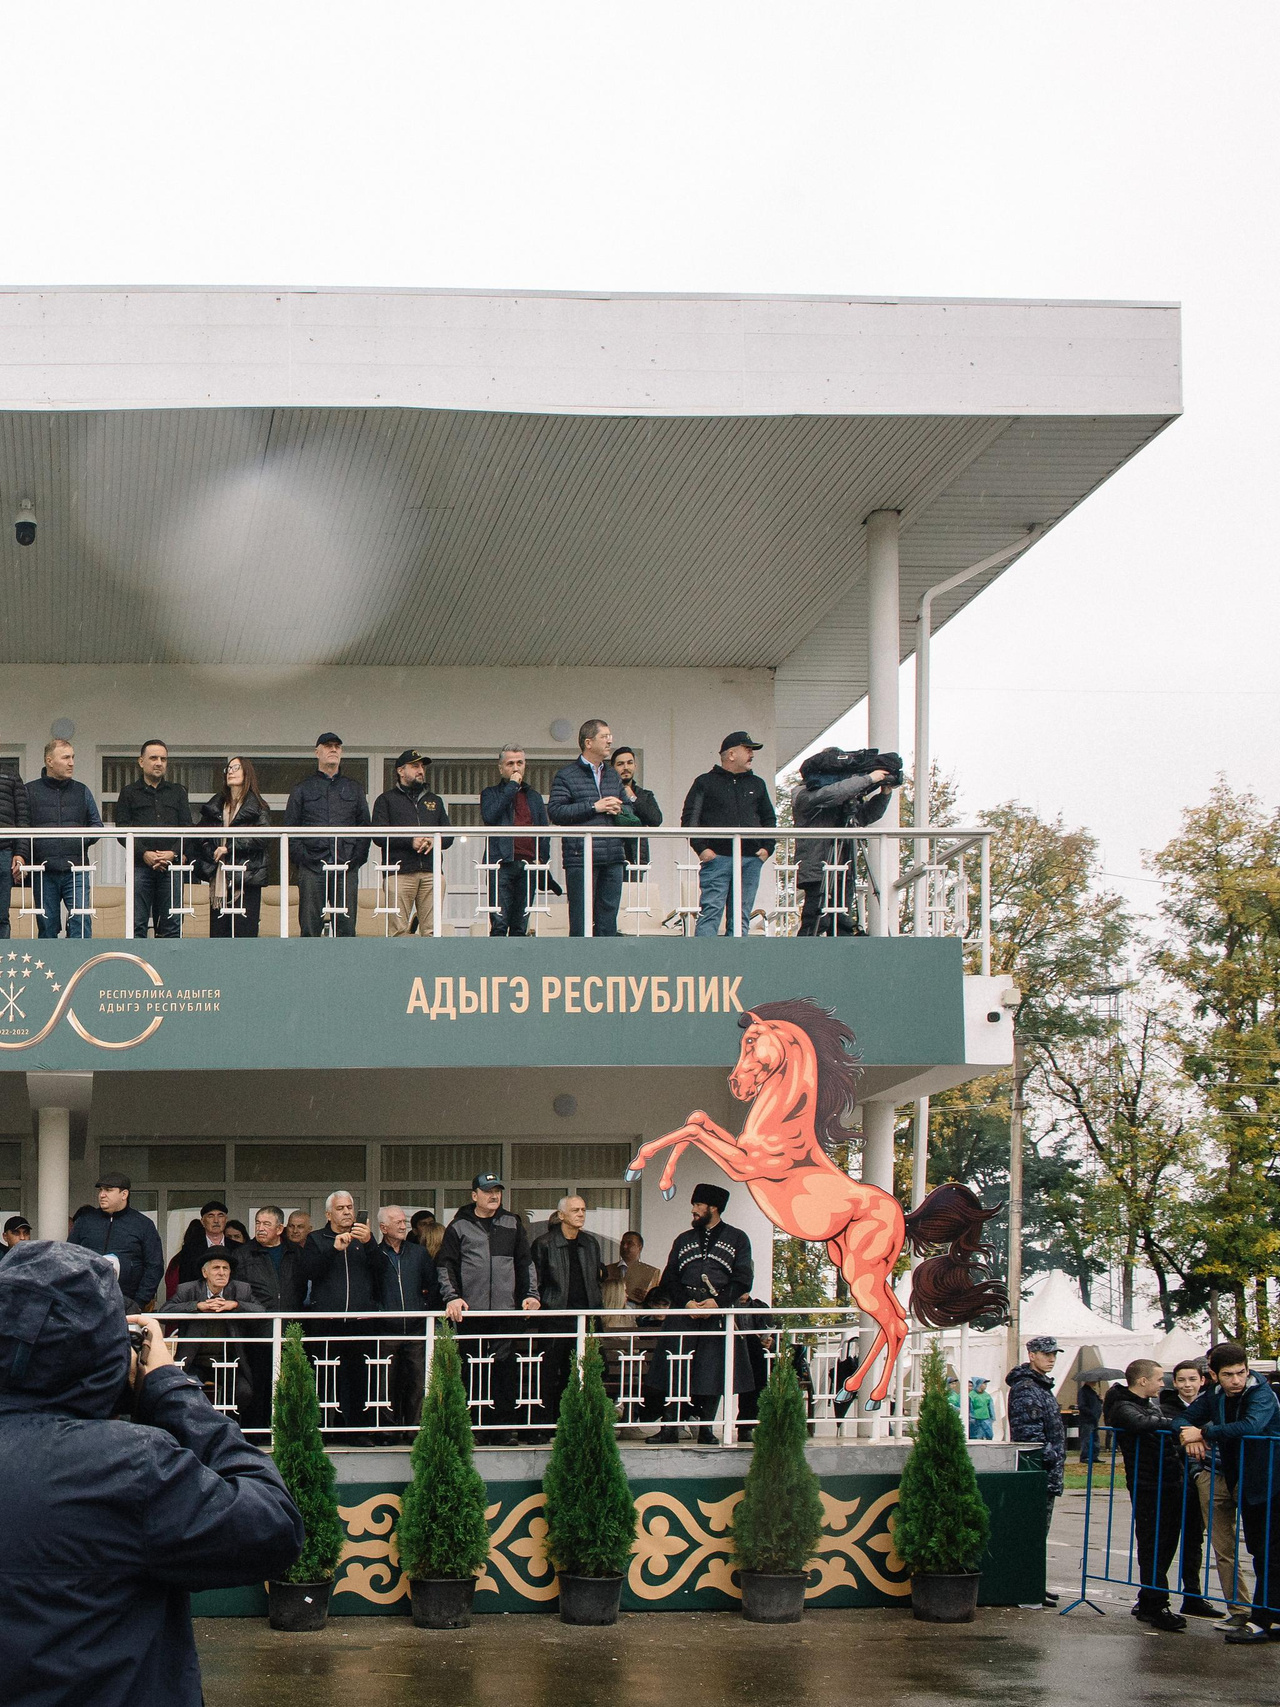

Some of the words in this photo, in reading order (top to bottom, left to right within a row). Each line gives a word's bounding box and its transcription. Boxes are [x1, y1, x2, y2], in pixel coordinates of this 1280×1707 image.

[99, 989, 173, 1000] РЕСПУБЛИКА
[176, 989, 222, 1001] АДЫГЕЯ
[406, 976, 530, 1021] АДЫГЭ
[541, 976, 746, 1013] РЕСПУБЛИК
[98, 1002, 141, 1014] АДЫГЭ
[146, 1002, 221, 1013] РЕСПУБЛИК
